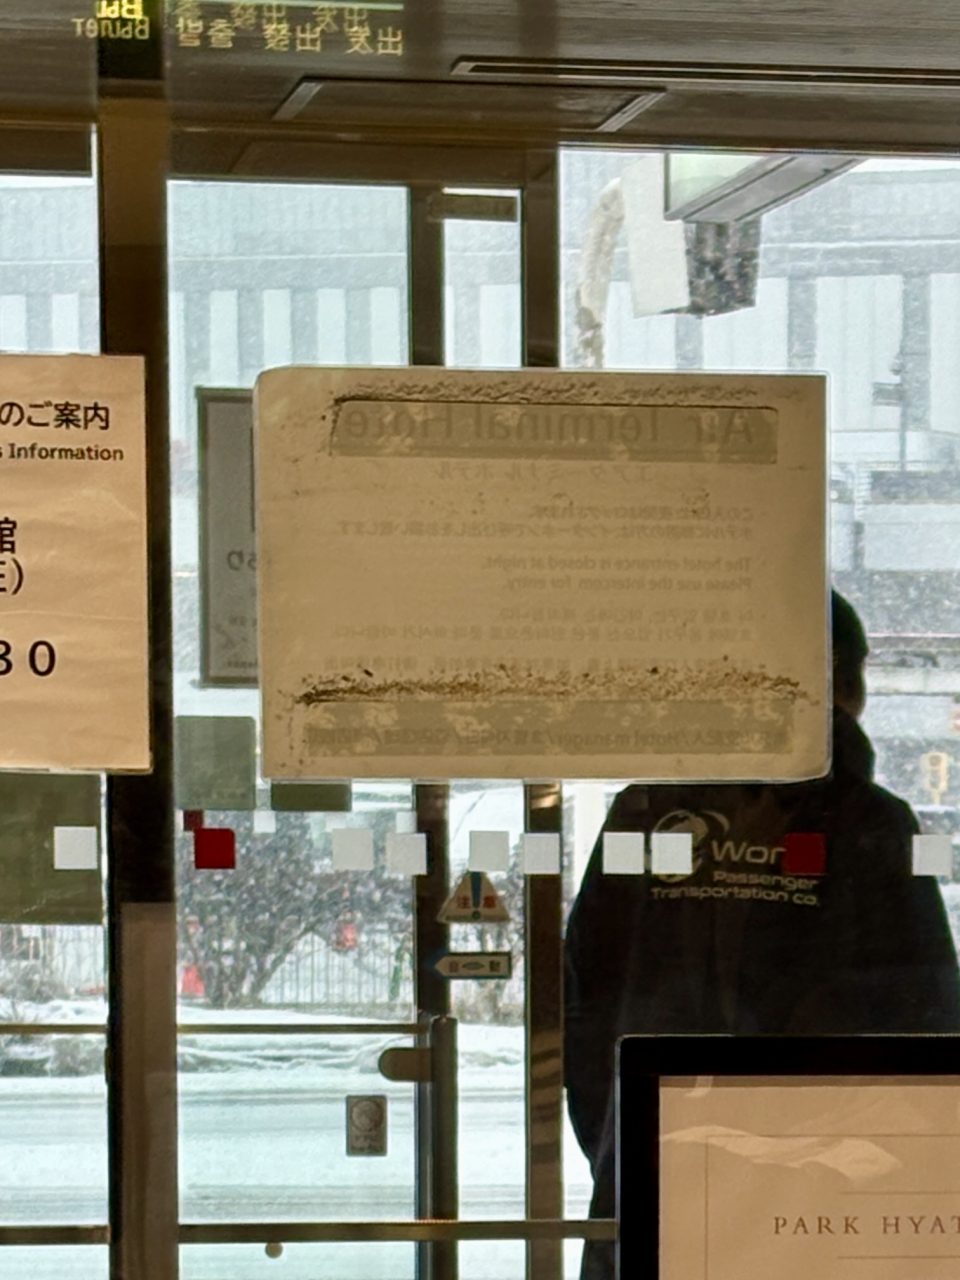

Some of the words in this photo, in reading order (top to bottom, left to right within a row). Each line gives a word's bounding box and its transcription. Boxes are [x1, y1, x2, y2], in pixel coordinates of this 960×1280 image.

[0, 401, 110, 430] のご案内
[9, 443, 124, 461] Information
[713, 870, 819, 891] Passenger
[651, 886, 788, 902] Transportation
[773, 1216, 861, 1235] PARK
